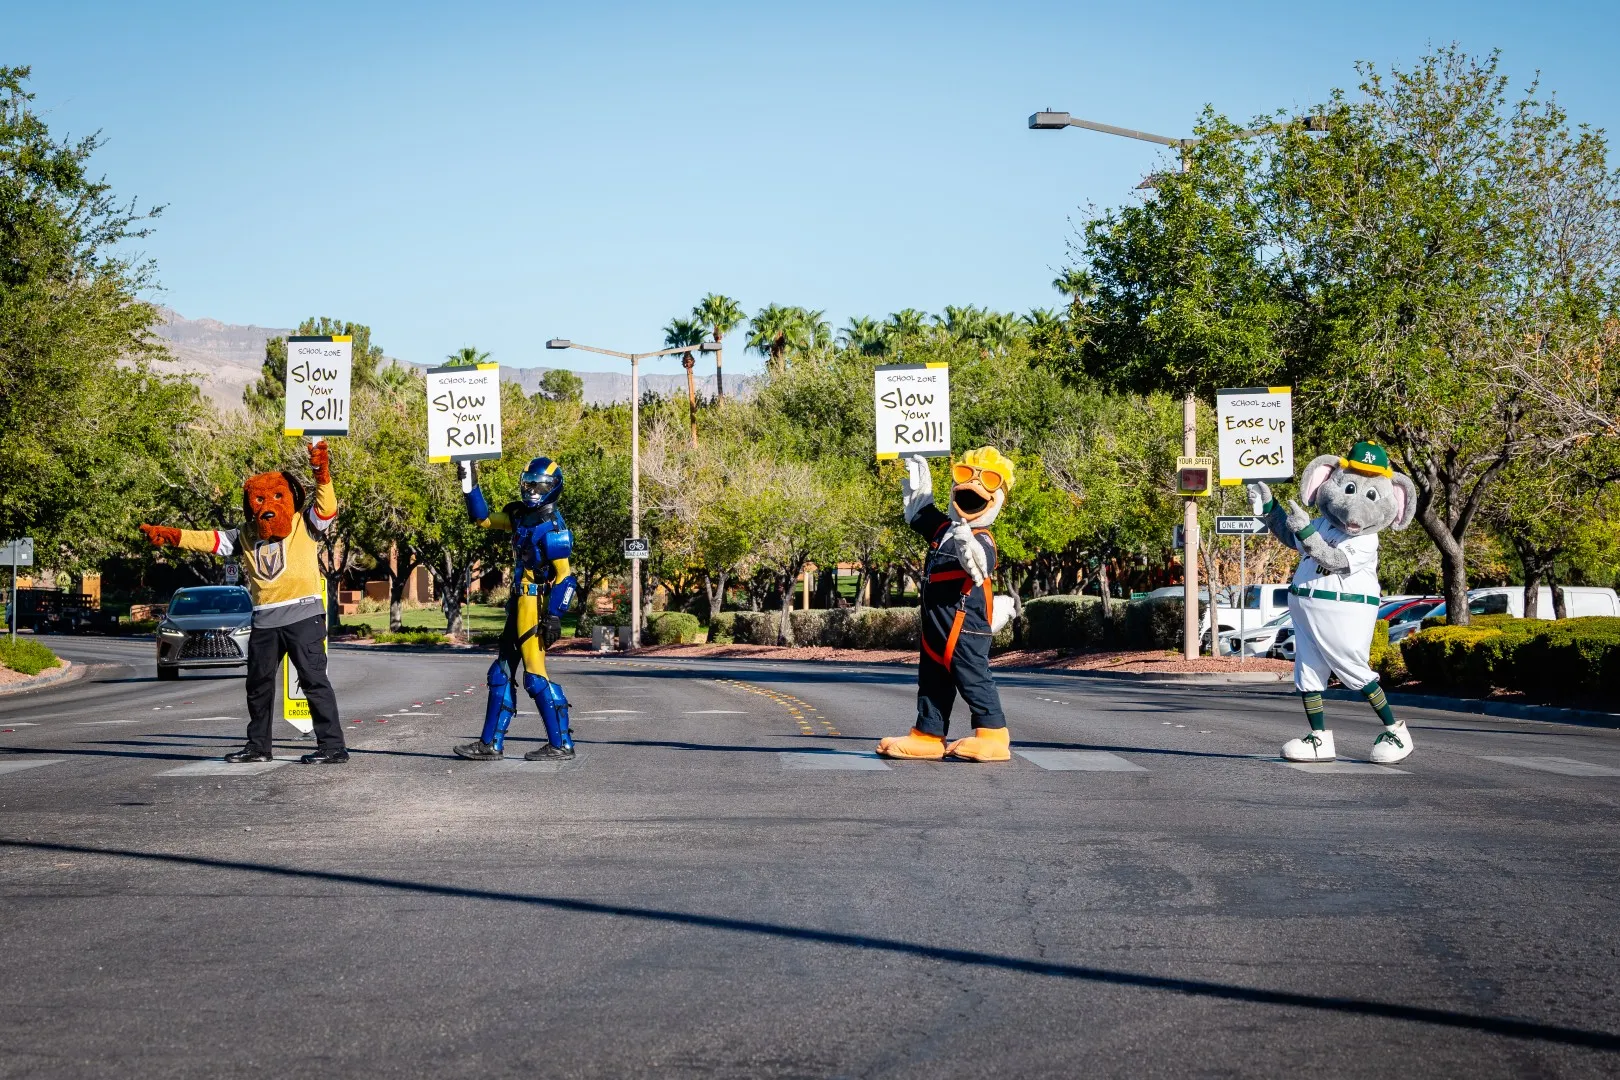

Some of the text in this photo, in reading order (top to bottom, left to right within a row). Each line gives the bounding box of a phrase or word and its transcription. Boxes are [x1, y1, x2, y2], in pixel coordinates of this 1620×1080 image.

[324, 349, 341, 357] ZONE
[291, 361, 337, 383] Slow
[439, 377, 488, 385] SCHOOL ZONE
[887, 375, 915, 383] SCHOOL
[308, 385, 333, 396] Your
[432, 390, 485, 412] Slow
[880, 387, 934, 409] Slow
[301, 398, 343, 421] Roll!
[1261, 400, 1281, 408] ZONE
[453, 412, 482, 424] Your
[901, 410, 930, 421] Your
[1225, 415, 1264, 430] Ease
[446, 423, 495, 447] Roll!
[894, 421, 943, 444] Roll!
[1251, 435, 1270, 445] the
[1239, 445, 1284, 467] Gas!
[1194, 458, 1212, 466] SPEED
[1221, 521, 1253, 529] ONE WAY
